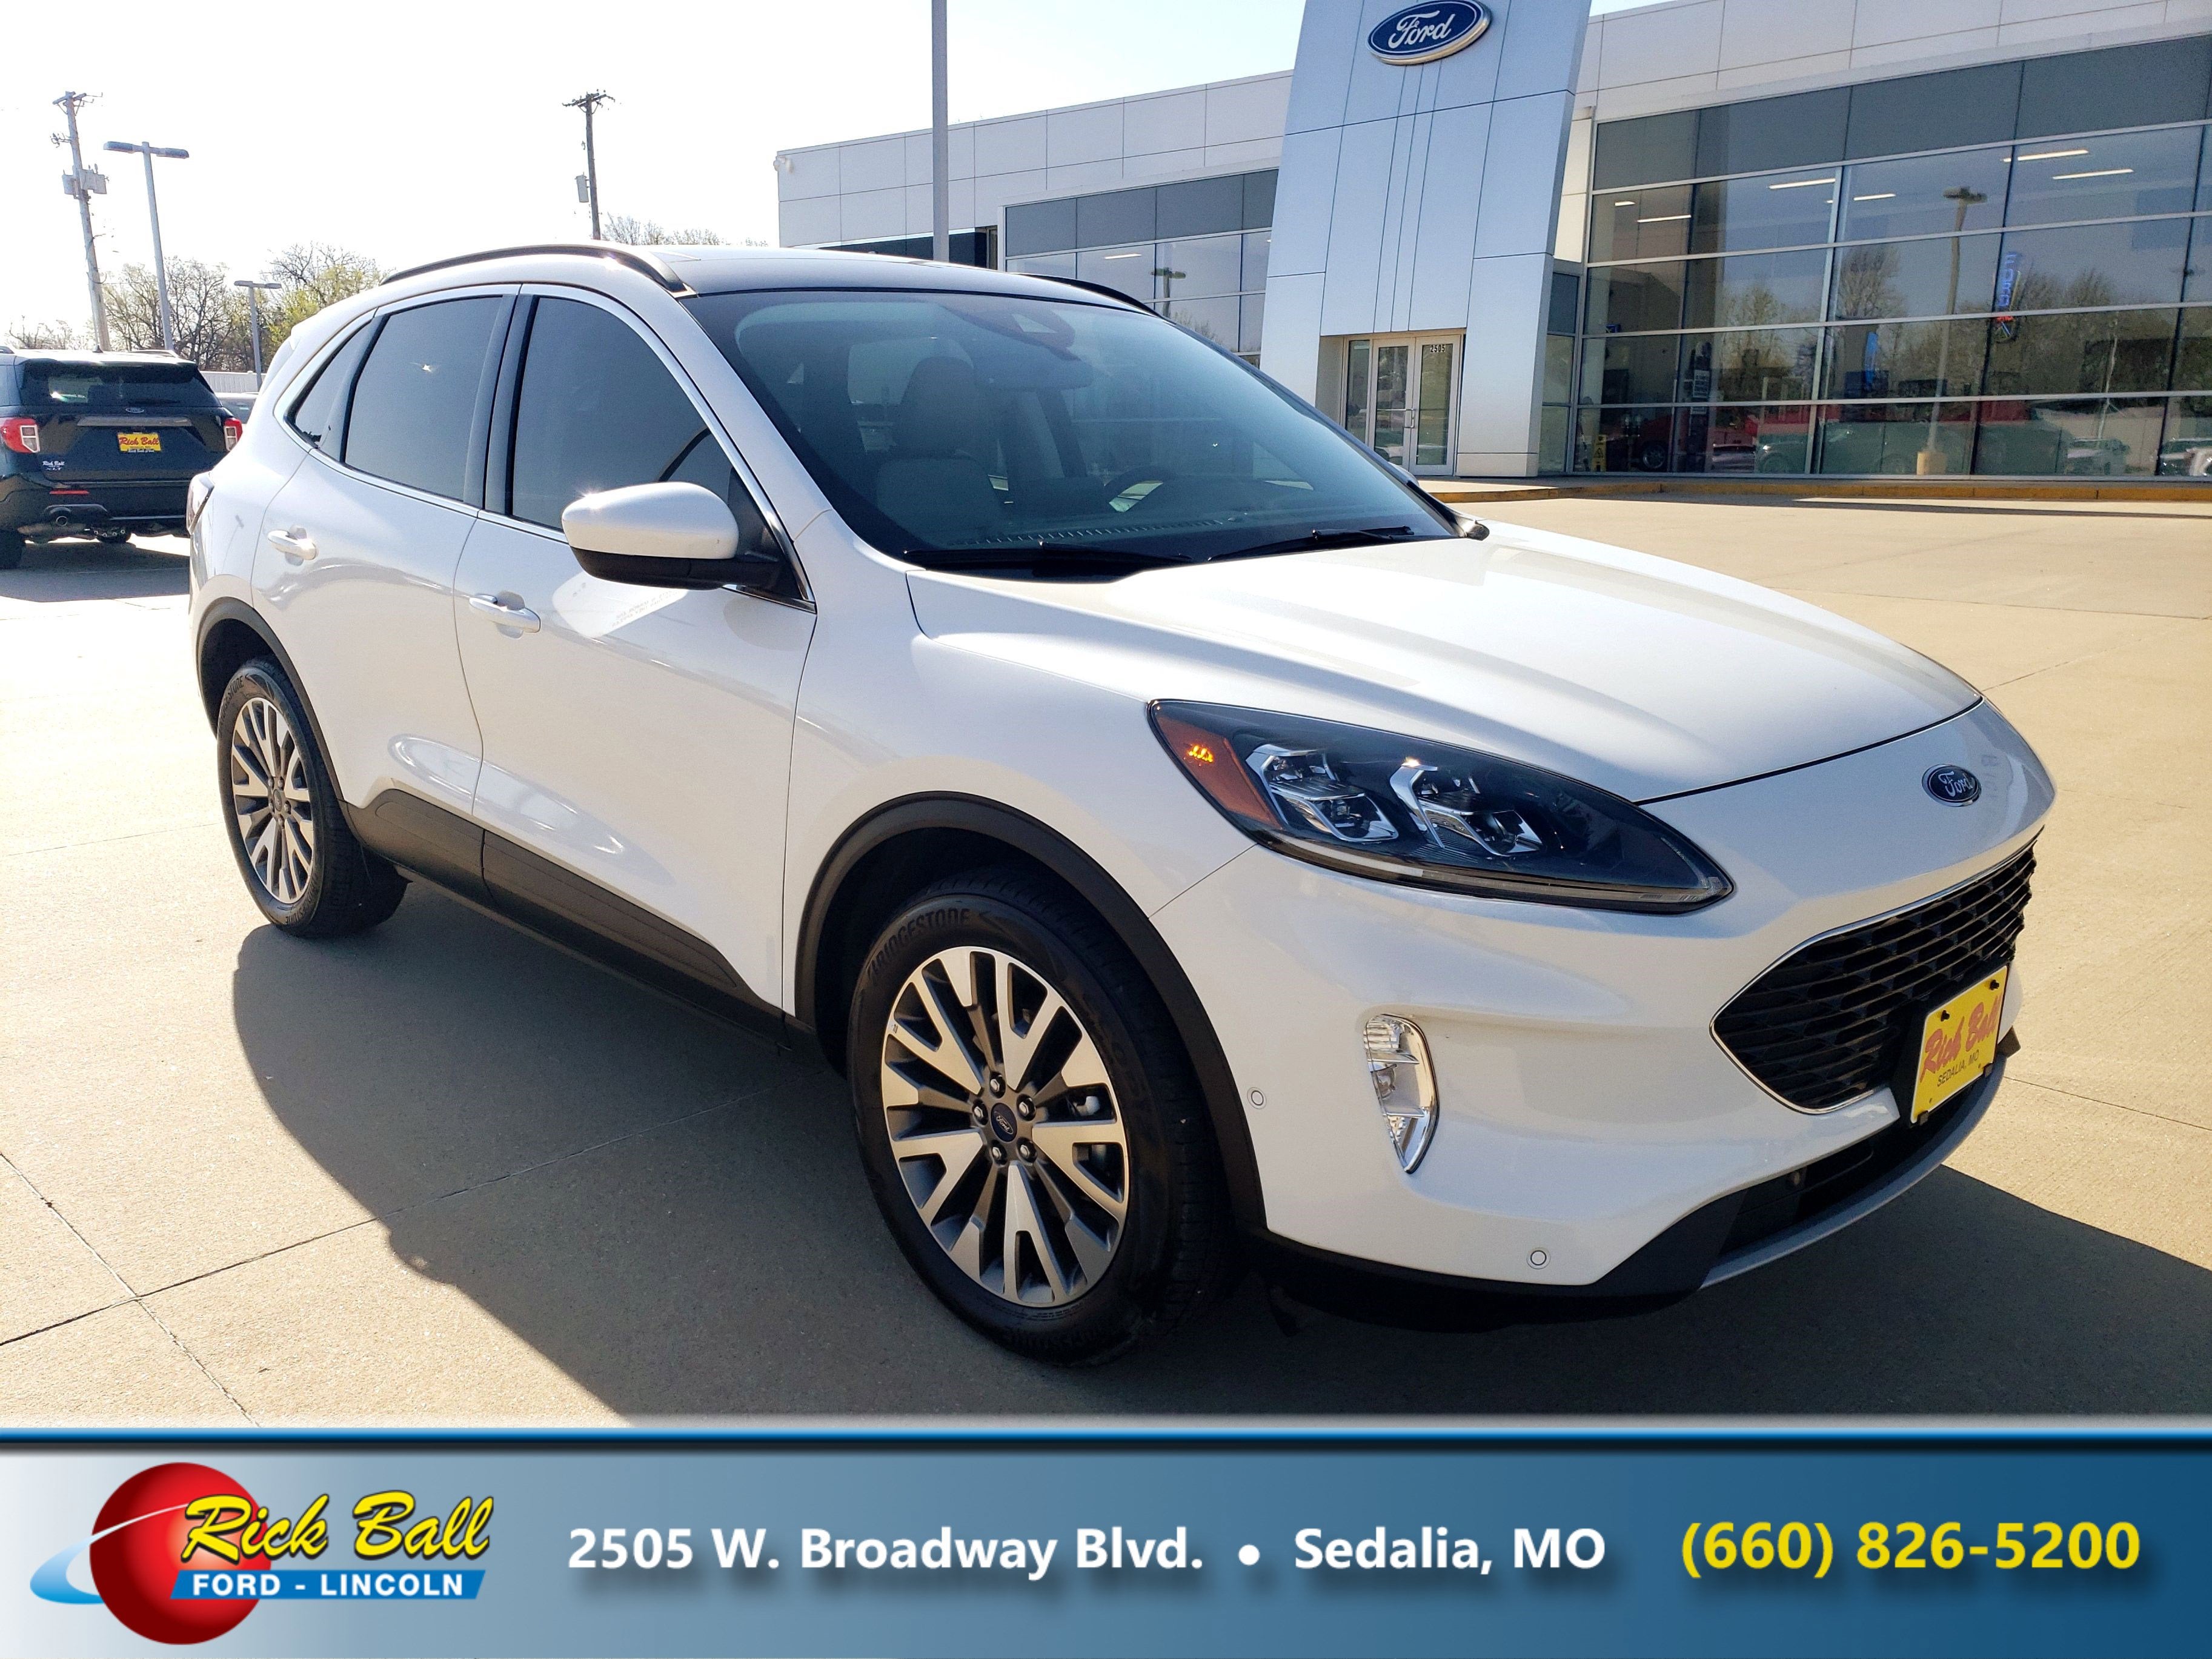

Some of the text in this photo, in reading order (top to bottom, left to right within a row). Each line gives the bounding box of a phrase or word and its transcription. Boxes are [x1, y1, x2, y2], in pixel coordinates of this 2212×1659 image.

[1388, 10, 1455, 48] Ford
[1430, 344, 1446, 353] 2505
[119, 437, 159, 445] Rick Ball
[1938, 771, 1973, 797] Ford
[1920, 990, 2002, 1083] Rick Ball
[1937, 1049, 1980, 1087] SEDALIA, MO
[996, 1115, 1010, 1132] Ford
